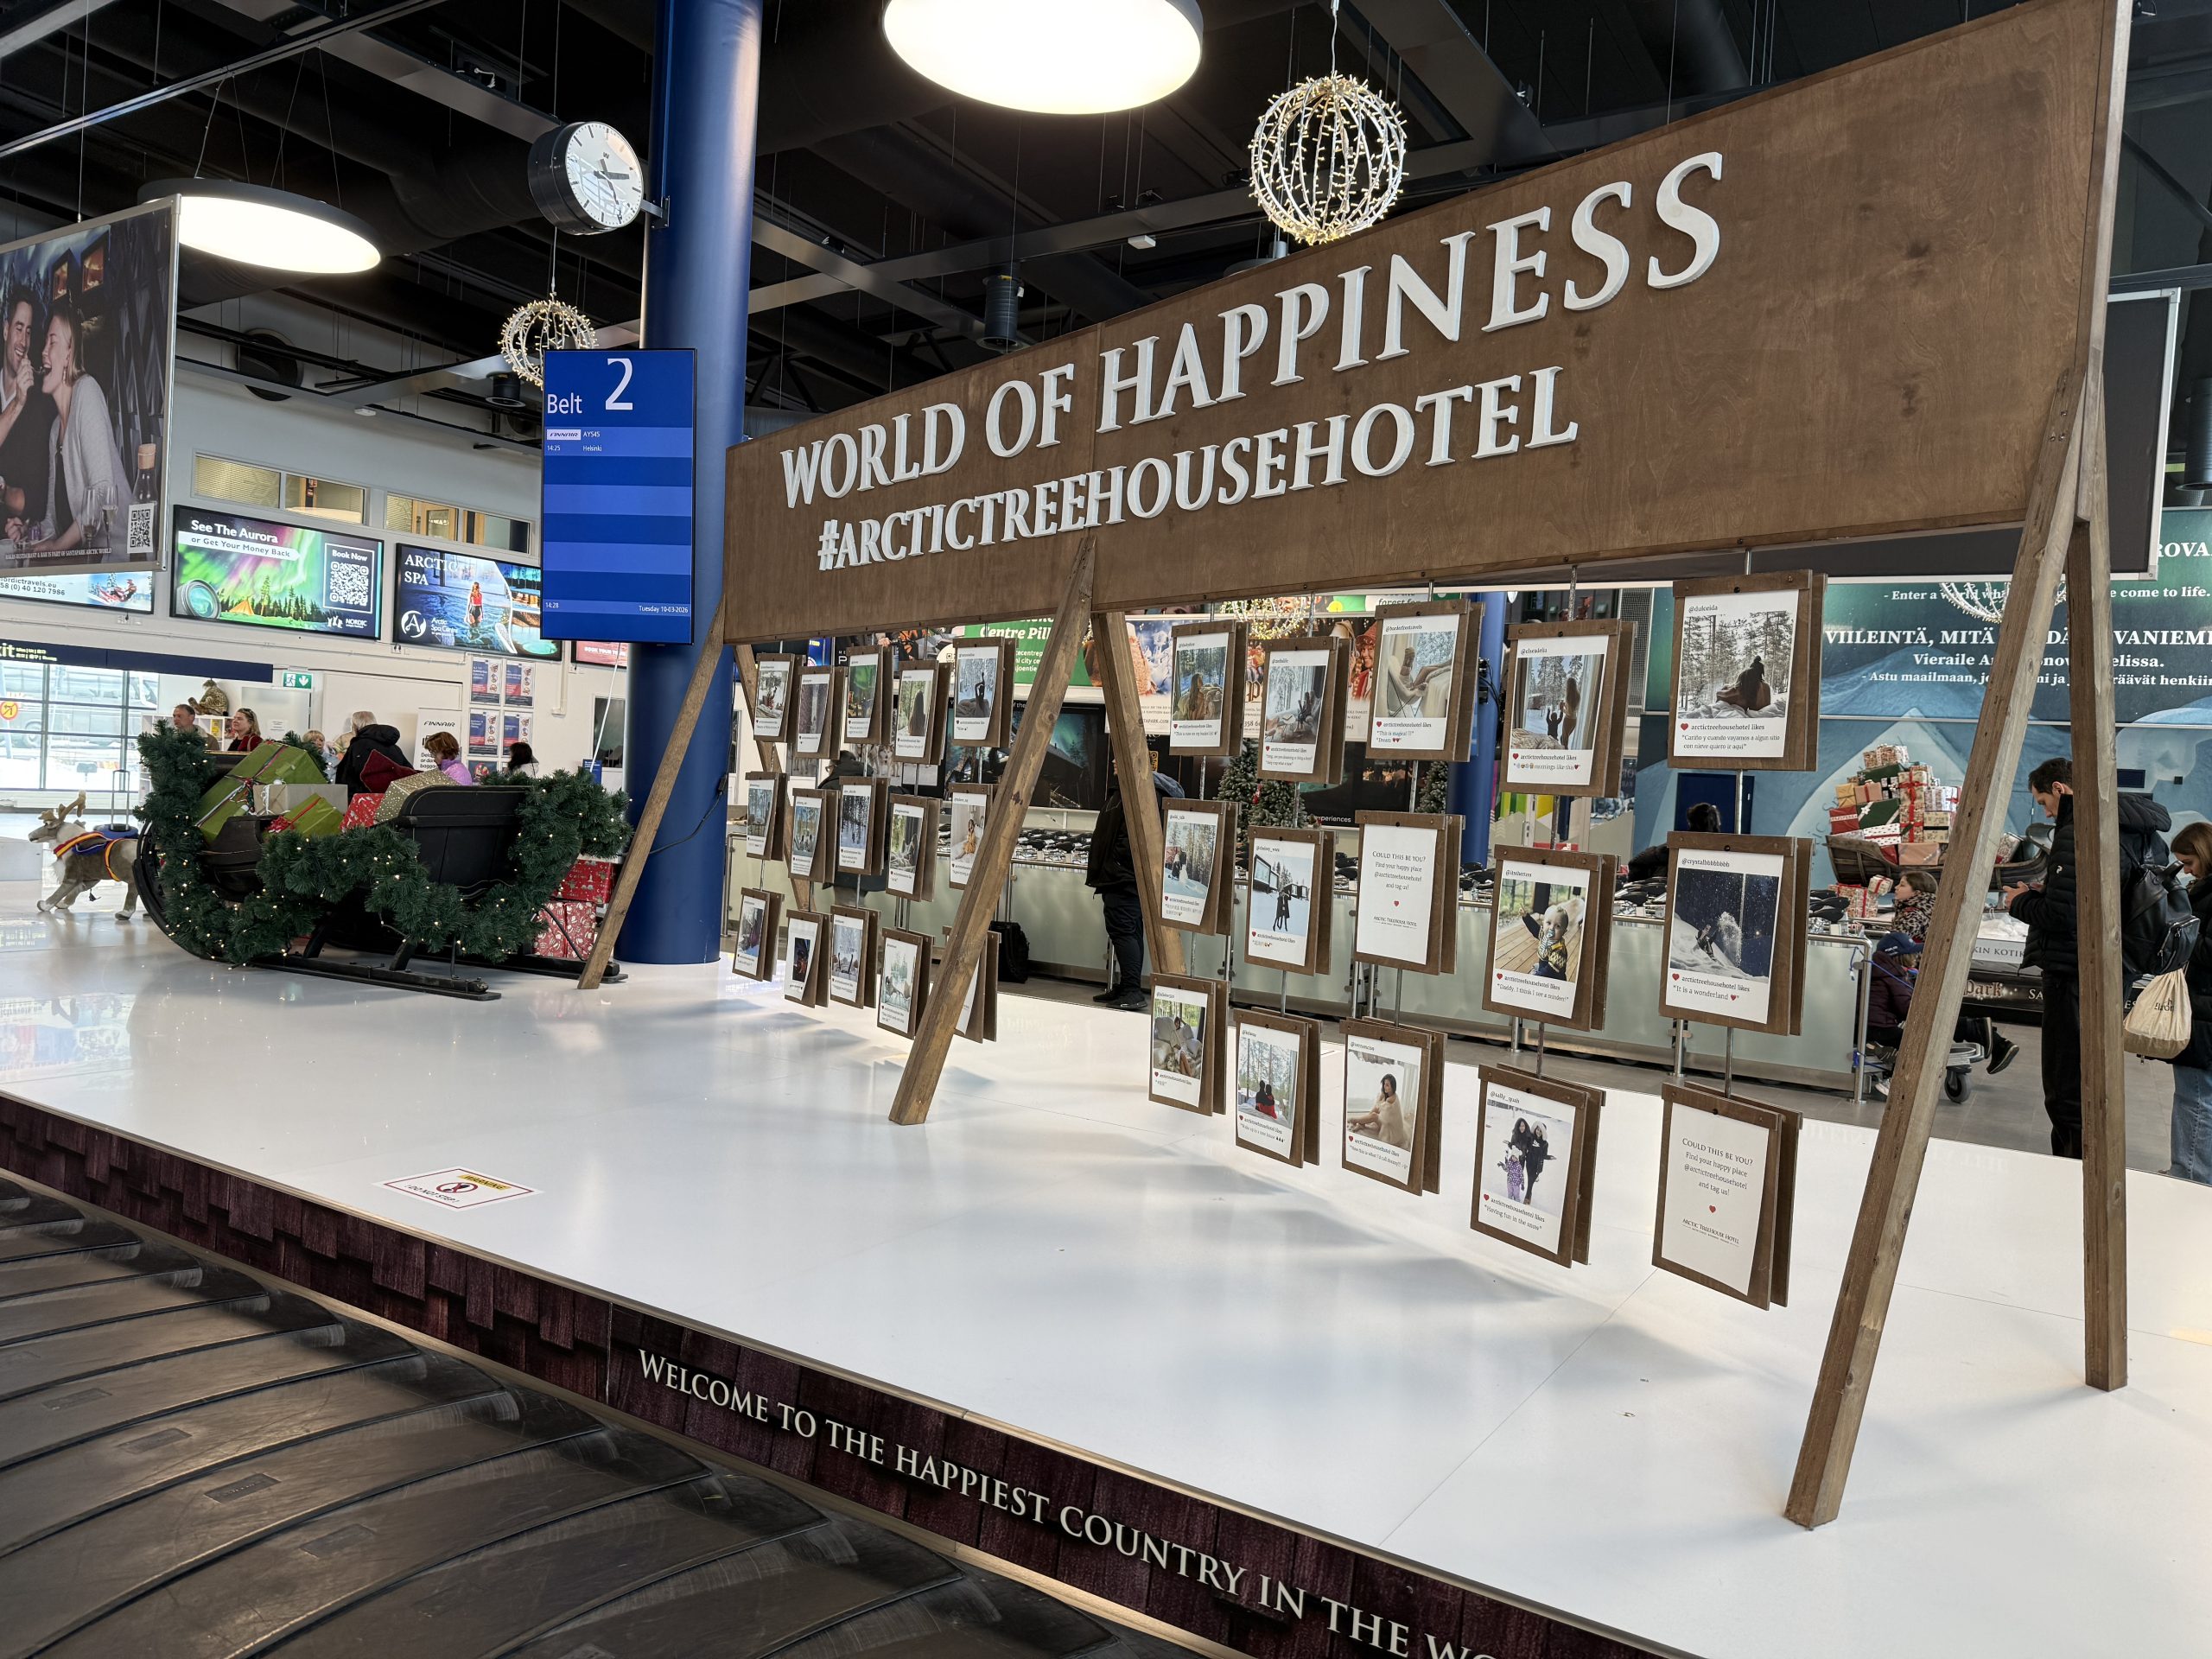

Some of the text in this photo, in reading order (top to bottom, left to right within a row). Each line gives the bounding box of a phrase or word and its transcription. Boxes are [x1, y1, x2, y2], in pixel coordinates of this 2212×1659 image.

[780, 152, 1723, 509] WORLD OF HAPPINESS
[547, 358, 633, 414] Belt 2
[817, 366, 1579, 571] #ARCTICTREEHOUSEHOTEL
[191, 519, 278, 543] See The Aurora
[203, 537, 219, 546] Get
[221, 541, 241, 550] Your
[243, 543, 270, 555] Money
[271, 549, 290, 557] Back
[332, 550, 368, 562] Book Now
[404, 554, 459, 572] ARCTIC
[404, 571, 429, 586] SPA
[1891, 590, 1928, 600] Enter
[2120, 588, 2159, 597] come
[2163, 587, 2177, 597] to
[2182, 586, 2210, 597] life.
[639, 605, 659, 613] Tuesday
[346, 618, 367, 627] NORDIC
[980, 626, 1026, 639] Centre
[1824, 627, 1934, 647] VIILEINTÄ,
[1940, 627, 1995, 645] MITÄ
[1913, 653, 1975, 665] Vieraile
[1870, 671, 1897, 681] Astu
[1901, 671, 1977, 684] maailmaan,
[2113, 673, 2156, 684] räävät
[1372, 850, 1390, 859] COULD
[1681, 976, 1751, 992] arctictreehousehotel likes
[1694, 989, 1728, 1000] wonderland
[1681, 1137, 1753, 1166] COULD THIS BE YOU?
[1686, 1151, 1748, 1177] Find your happy place
[464, 1175, 507, 1190] WARNING
[1684, 1163, 1747, 1190] @arctictreehousehotel
[1698, 1180, 1730, 1196] and tag us!
[1682, 1218, 1699, 1229] ARCTIC
[639, 1349, 769, 1423] WELCOME
[777, 1402, 817, 1439] TO
[825, 1419, 885, 1465] THE
[896, 1444, 1050, 1524] HAPPIEST
[1059, 1505, 1248, 1597] COUNTRY
[1258, 1573, 1307, 1620] IN
[1320, 1596, 1410, 1659] THE
